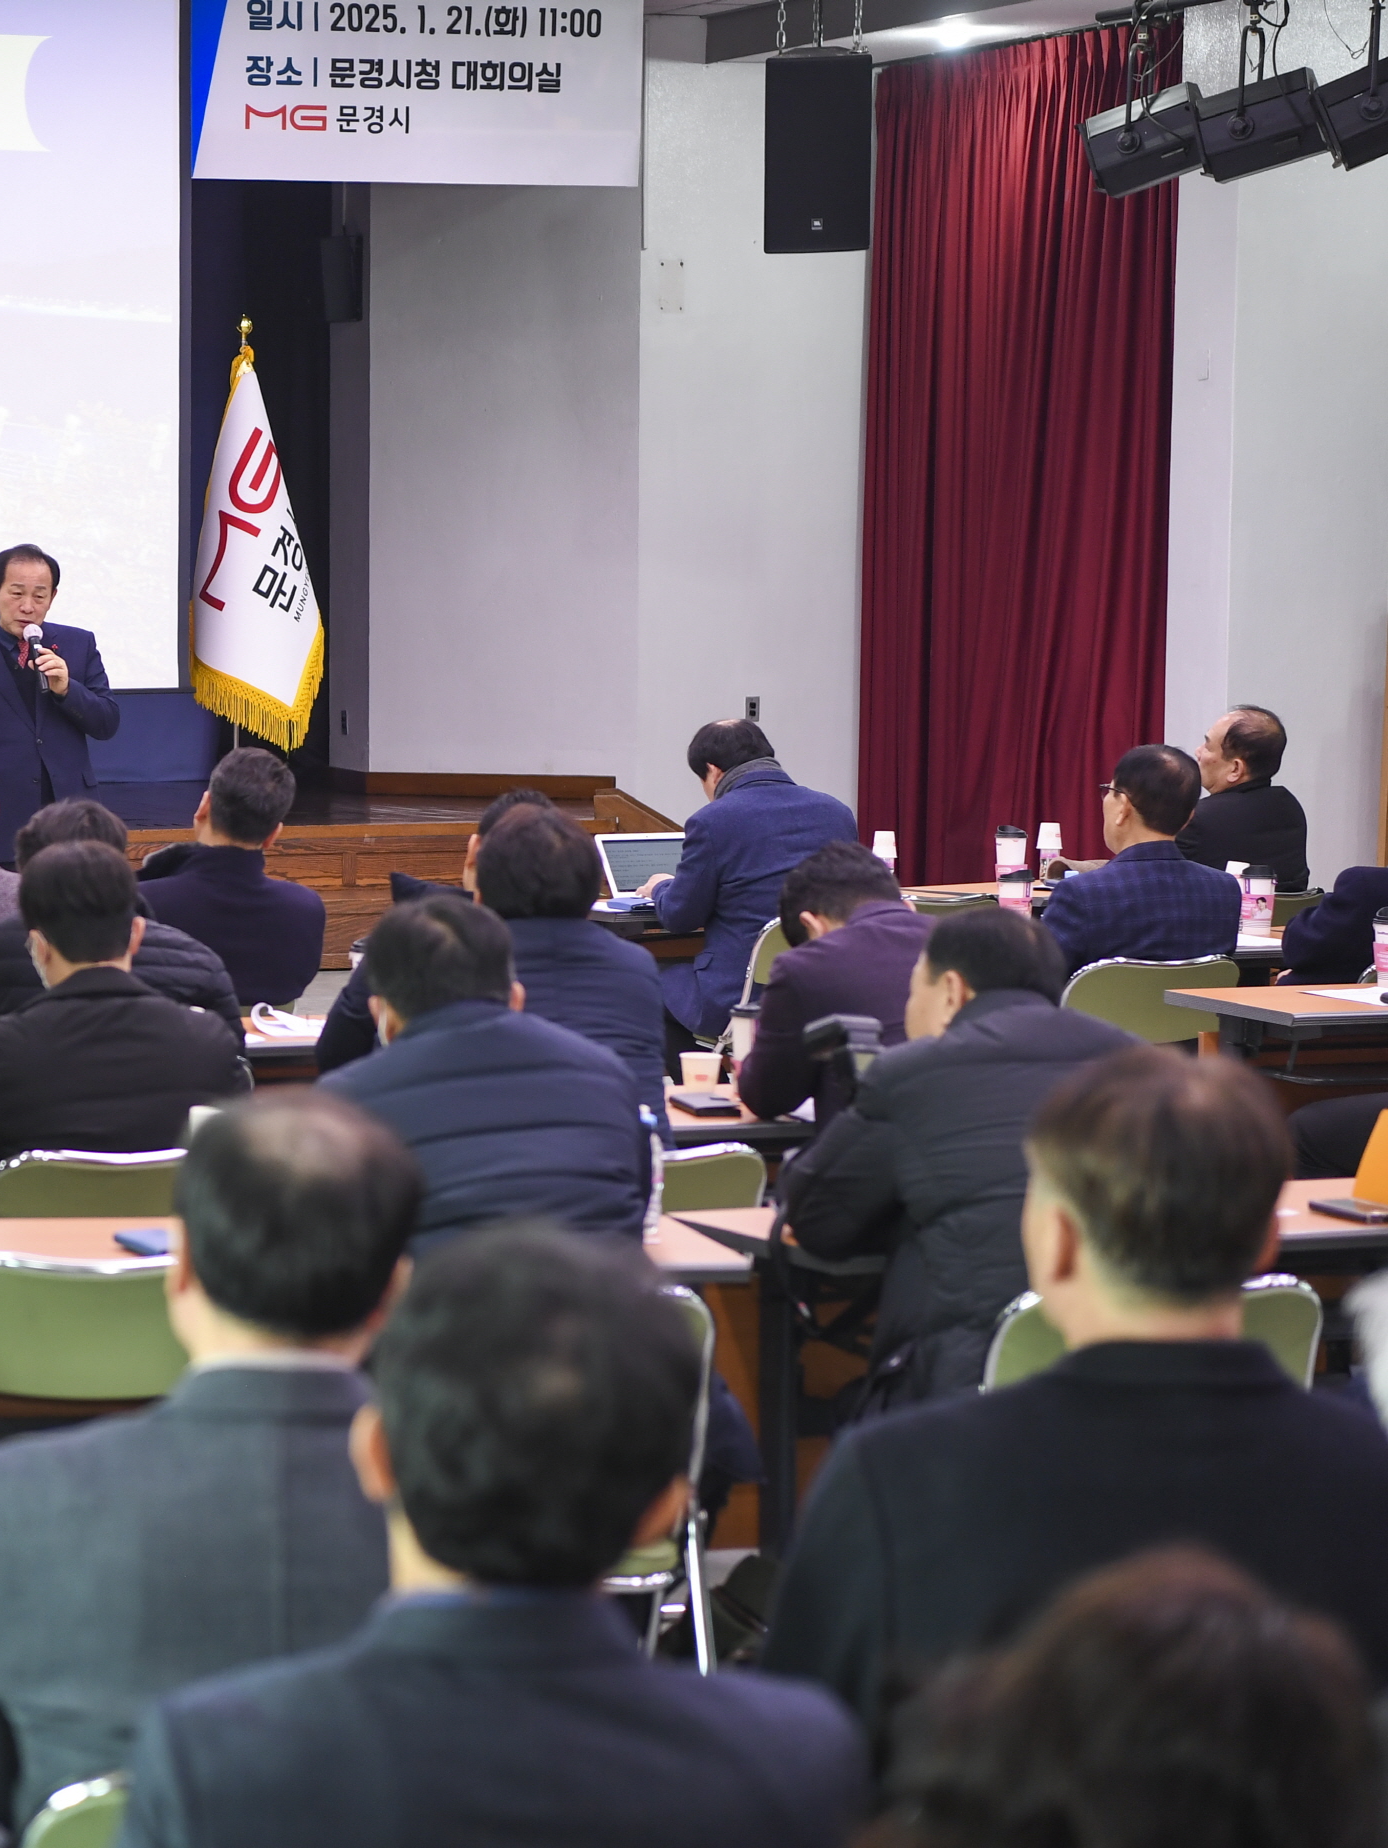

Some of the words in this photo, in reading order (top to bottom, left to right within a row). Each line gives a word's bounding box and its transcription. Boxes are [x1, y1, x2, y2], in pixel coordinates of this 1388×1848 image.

[246, 0, 303, 32] 일시
[329, 2, 407, 35] 2025.
[417, 5, 436, 36] 1.
[446, 6, 528, 38] 21.(화)
[538, 8, 602, 38] 11:00
[245, 56, 303, 87] 장소
[328, 58, 441, 91] 문경시청
[451, 60, 562, 94] 대회의실
[245, 103, 328, 132] MG
[336, 105, 411, 135] 문경시
